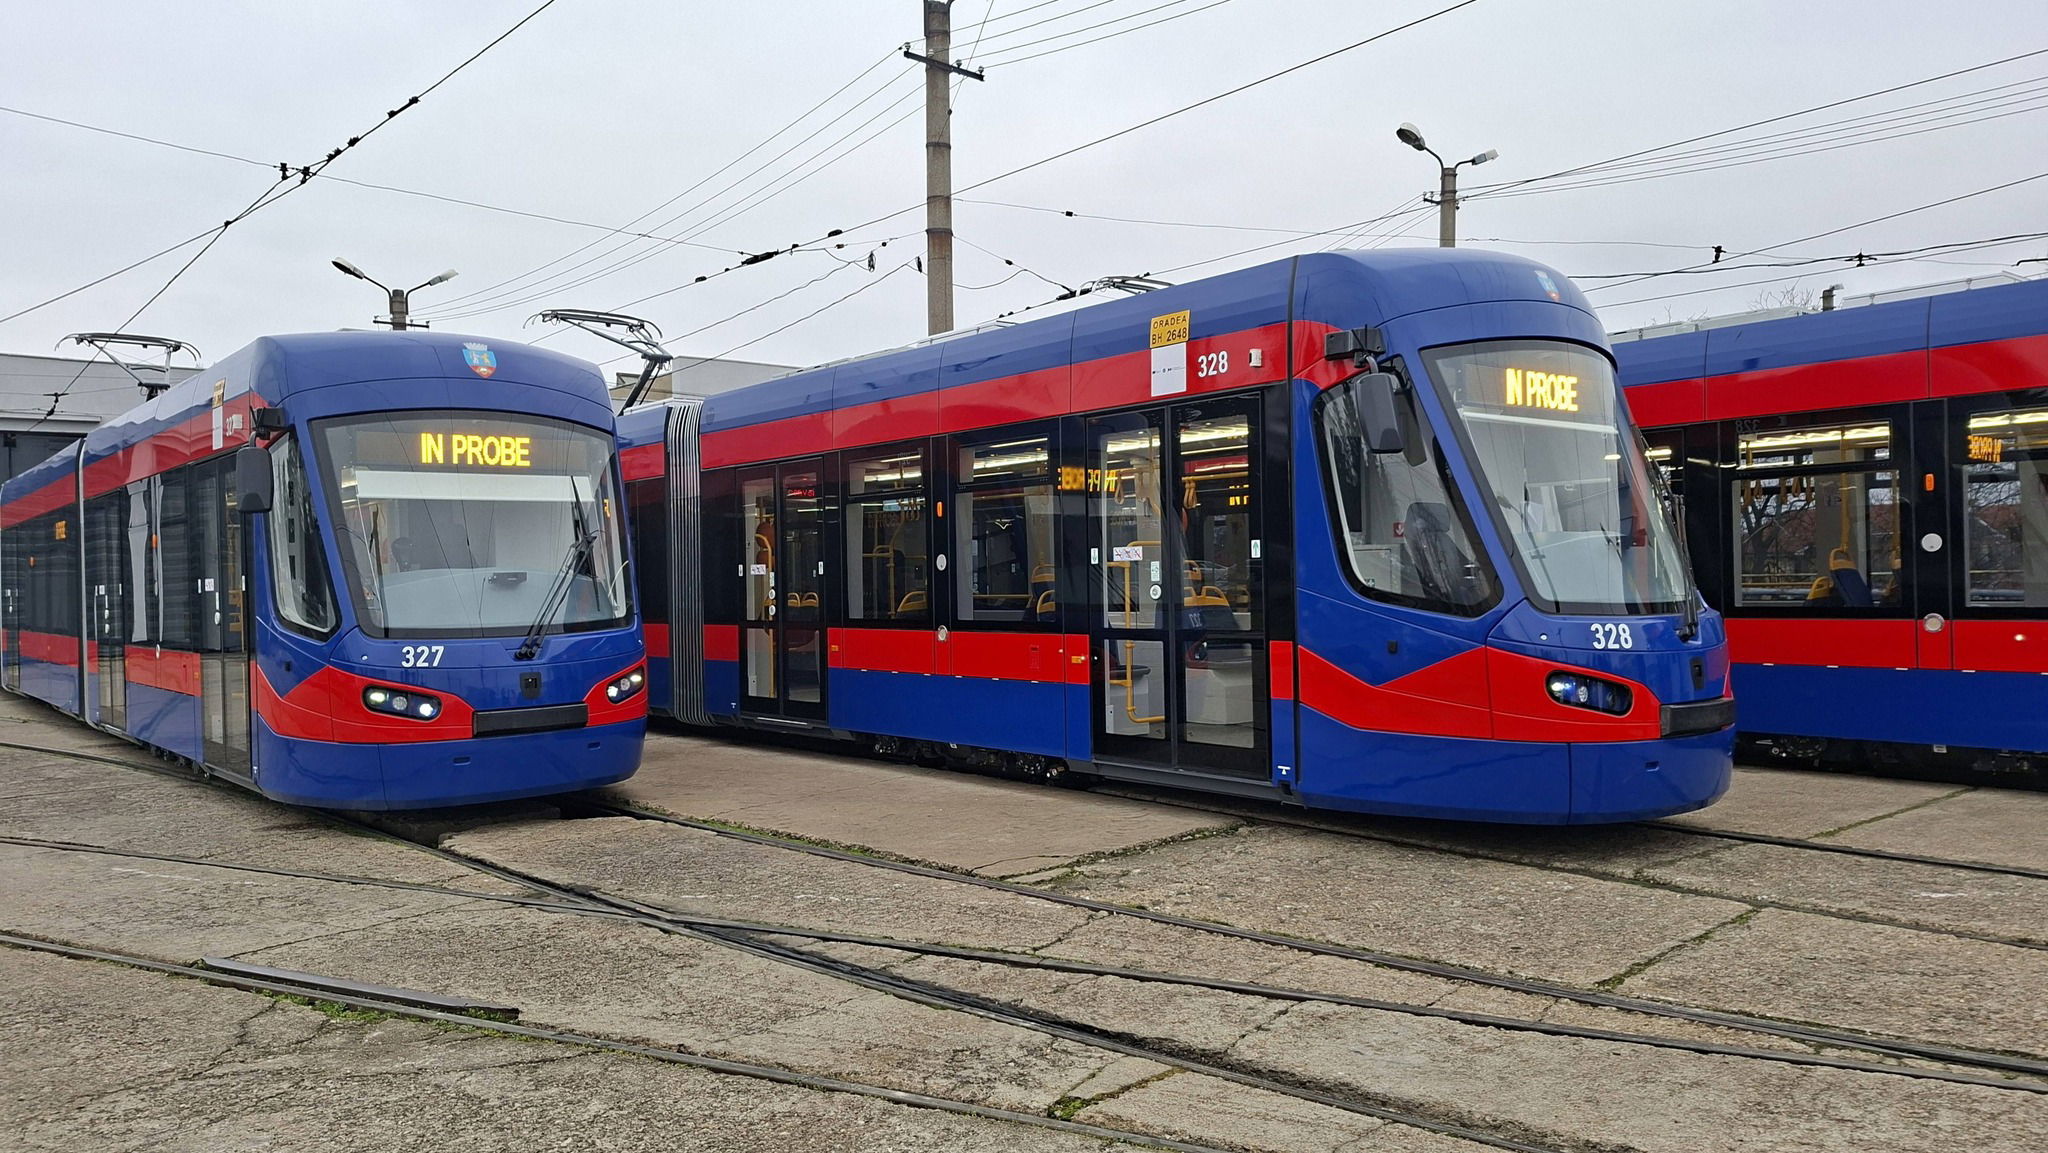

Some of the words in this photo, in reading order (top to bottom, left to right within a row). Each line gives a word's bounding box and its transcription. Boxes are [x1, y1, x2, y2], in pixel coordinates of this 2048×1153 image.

[1152, 333, 1163, 345] BH
[1166, 327, 1187, 342] 2648
[1153, 315, 1187, 330] ORADEA
[1198, 350, 1228, 378] 328
[1506, 368, 1523, 406] IN
[1526, 370, 1578, 412] PROBE
[421, 433, 444, 464] IN
[451, 434, 531, 467] PROBE
[1590, 623, 1633, 650] 328
[401, 645, 445, 668] 327
